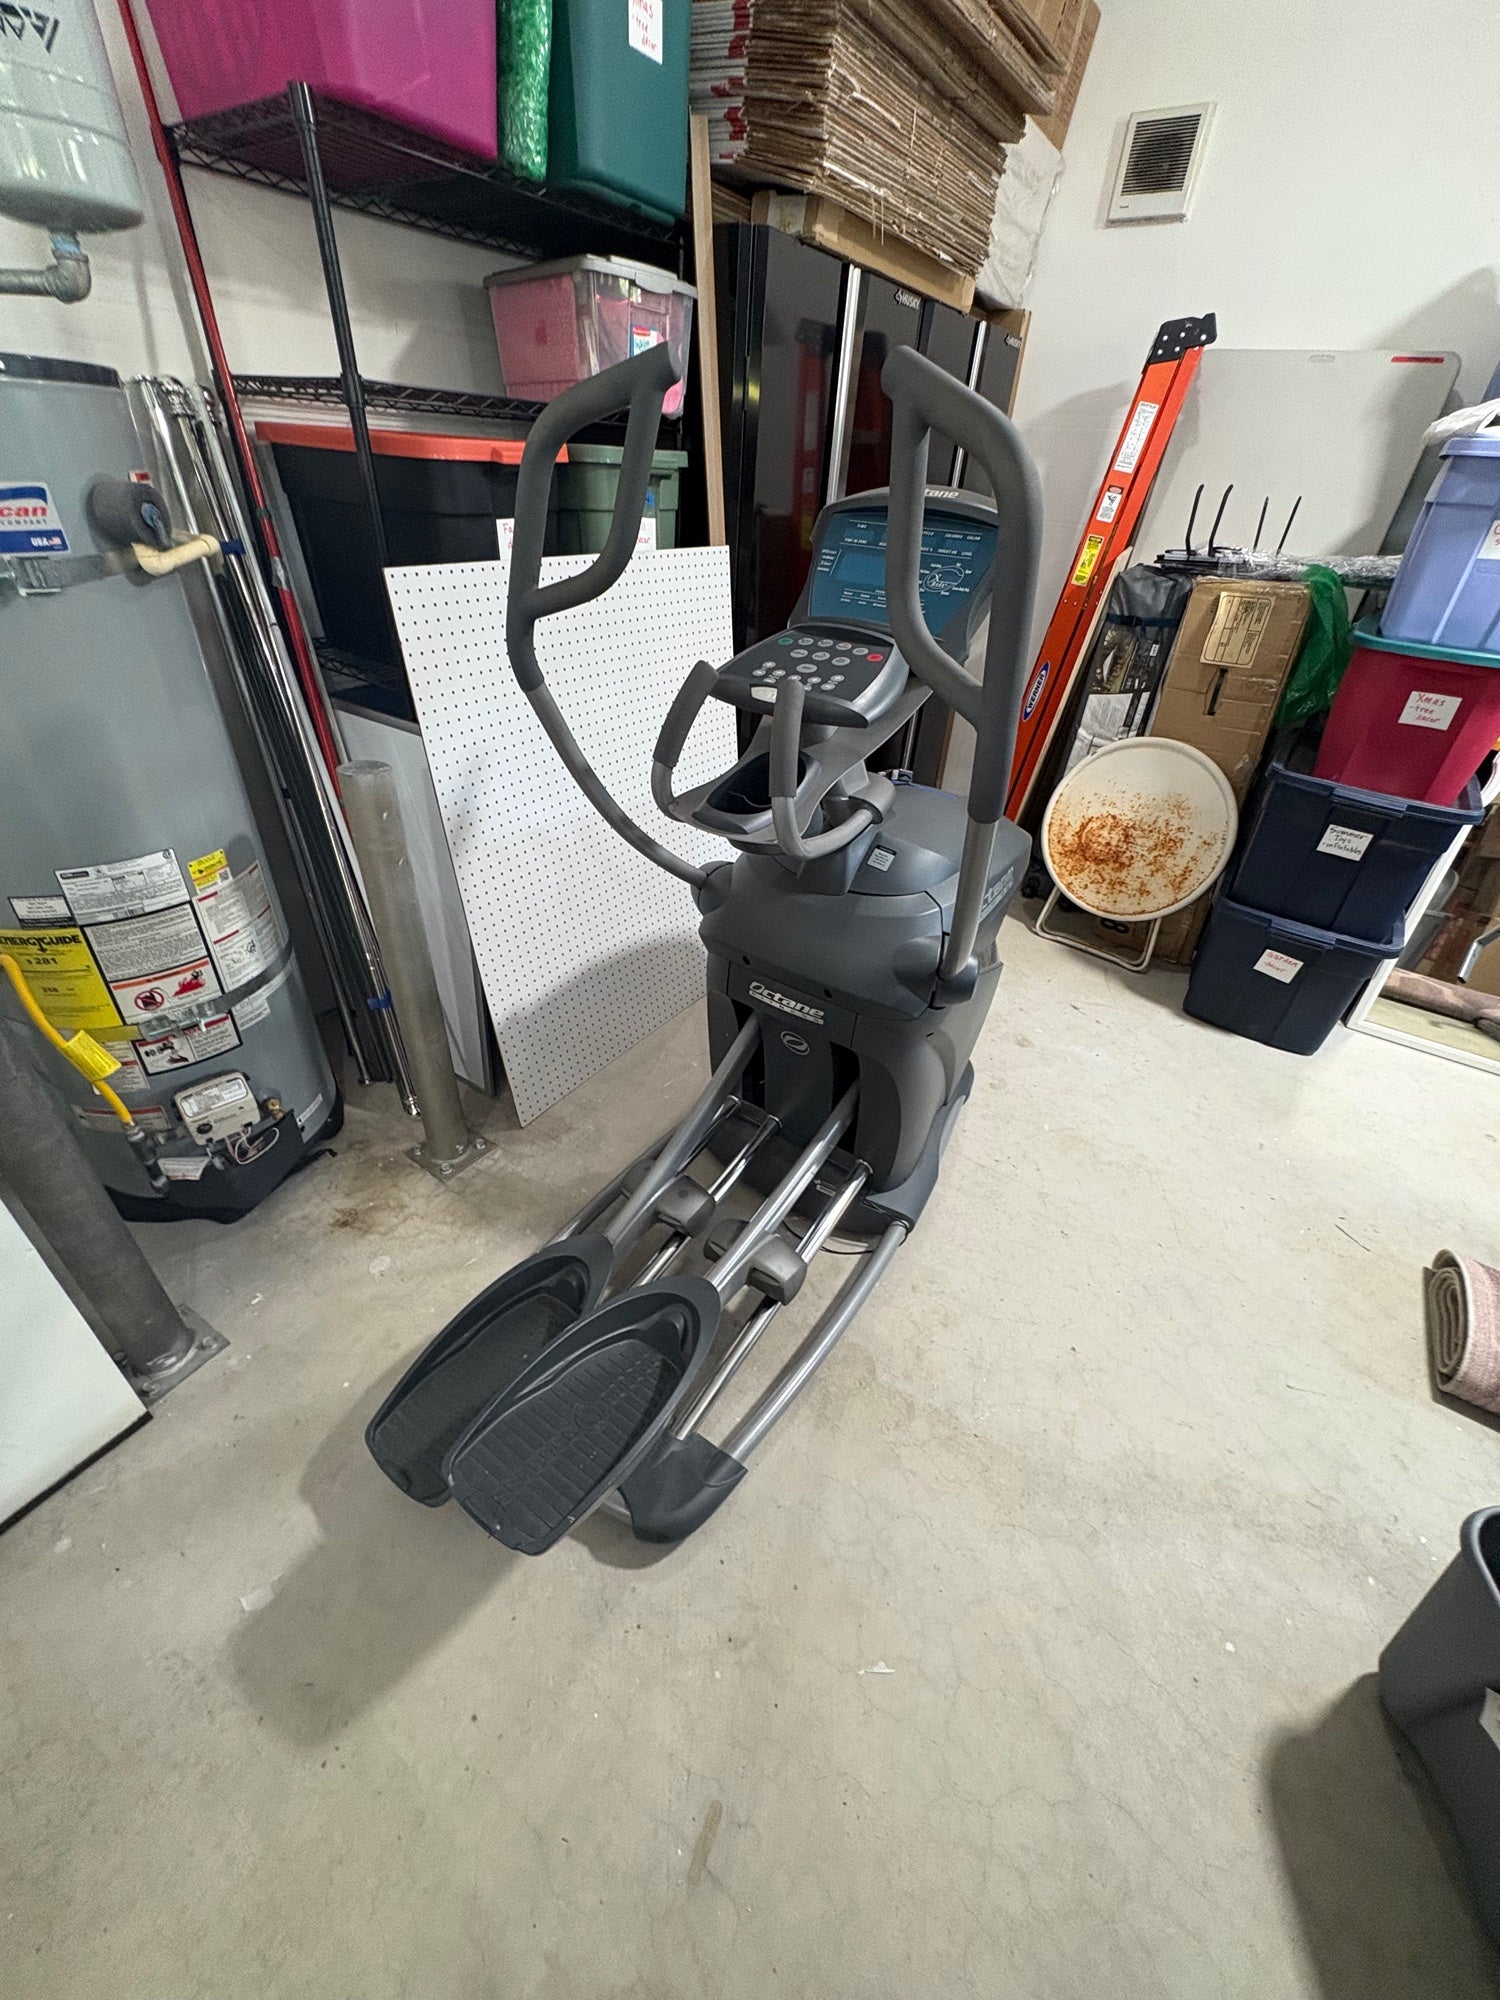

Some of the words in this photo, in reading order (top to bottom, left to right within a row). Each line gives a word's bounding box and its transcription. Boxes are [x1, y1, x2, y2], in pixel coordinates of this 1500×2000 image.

[902, 290, 922, 310] HUSKY
[925, 489, 959, 499] tane
[1028, 673, 1045, 709] WERNER
[1416, 693, 1446, 707] Xmas
[749, 981, 825, 1018] Octane
